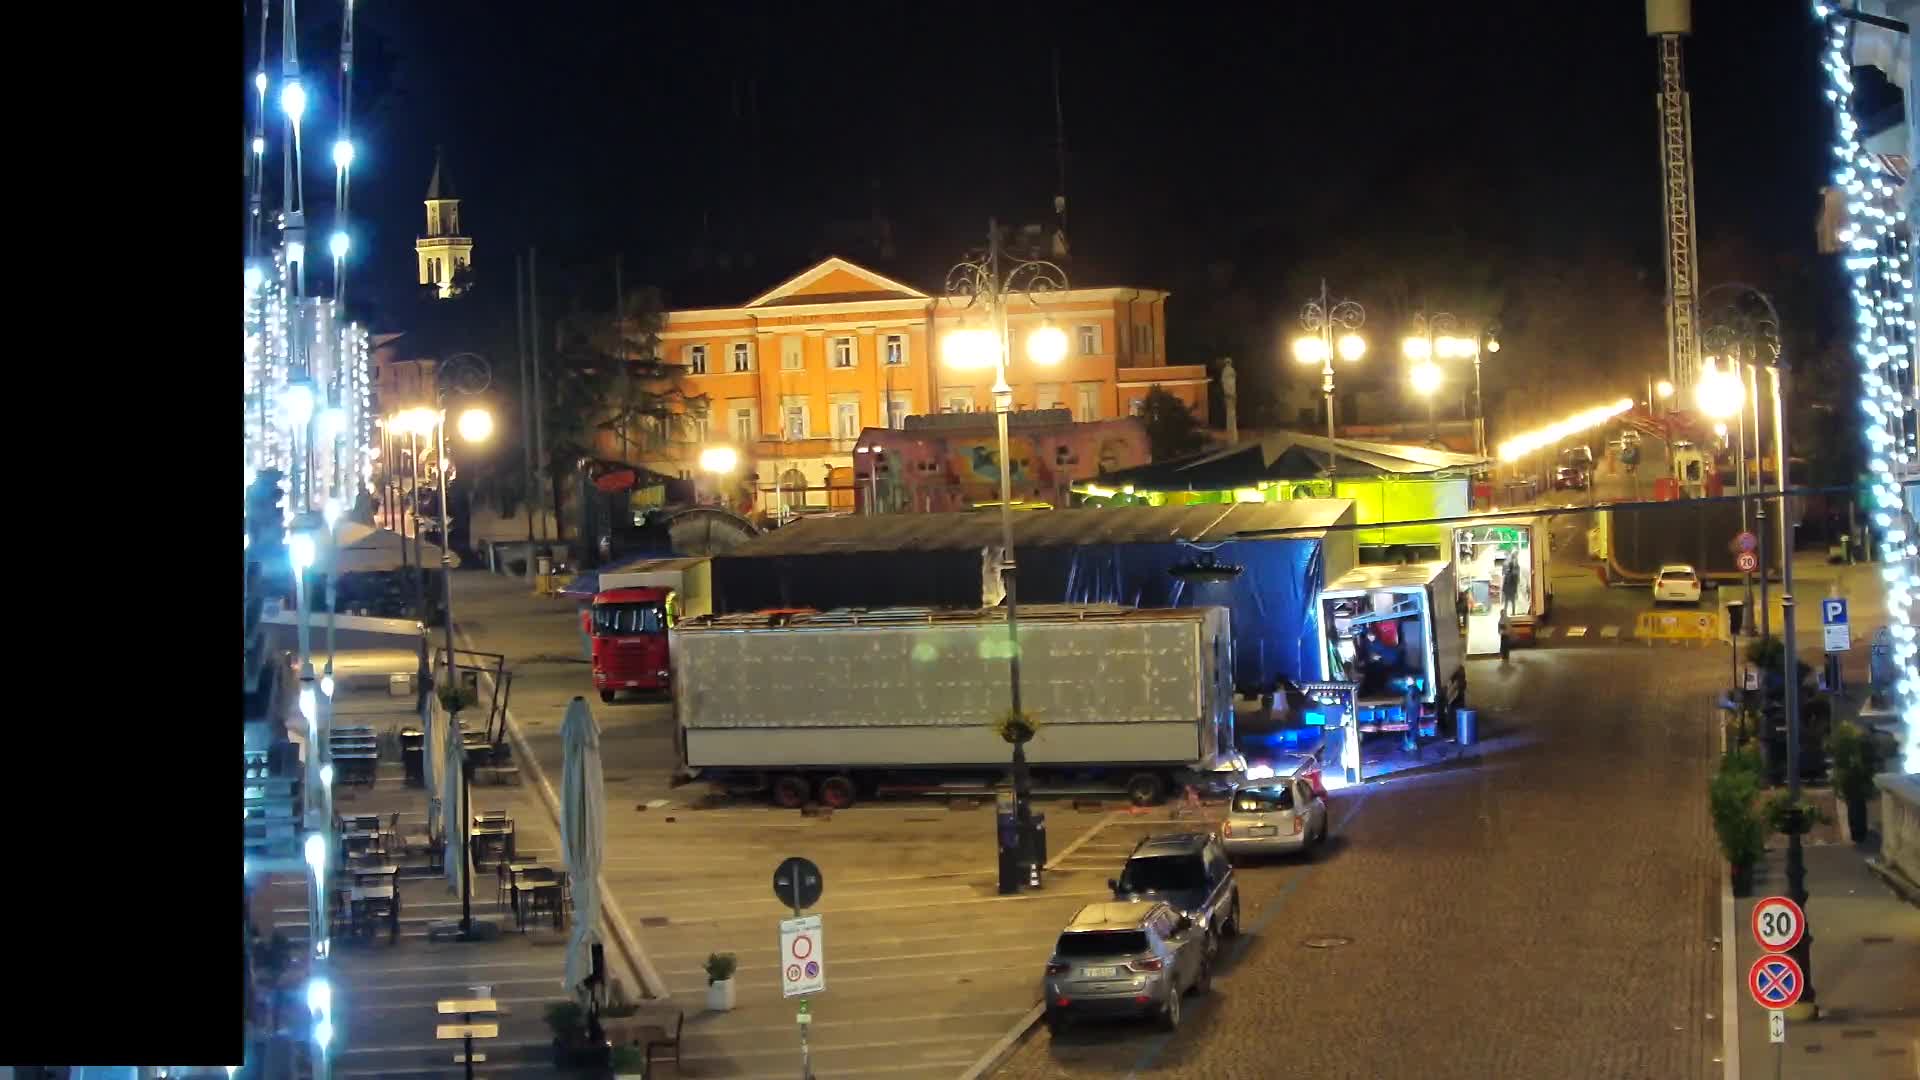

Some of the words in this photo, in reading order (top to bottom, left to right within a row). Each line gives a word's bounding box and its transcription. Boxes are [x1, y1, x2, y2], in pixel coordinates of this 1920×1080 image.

[1743, 557, 1753, 567] 20
[1826, 602, 1843, 622] P
[1763, 912, 1791, 937] 30
